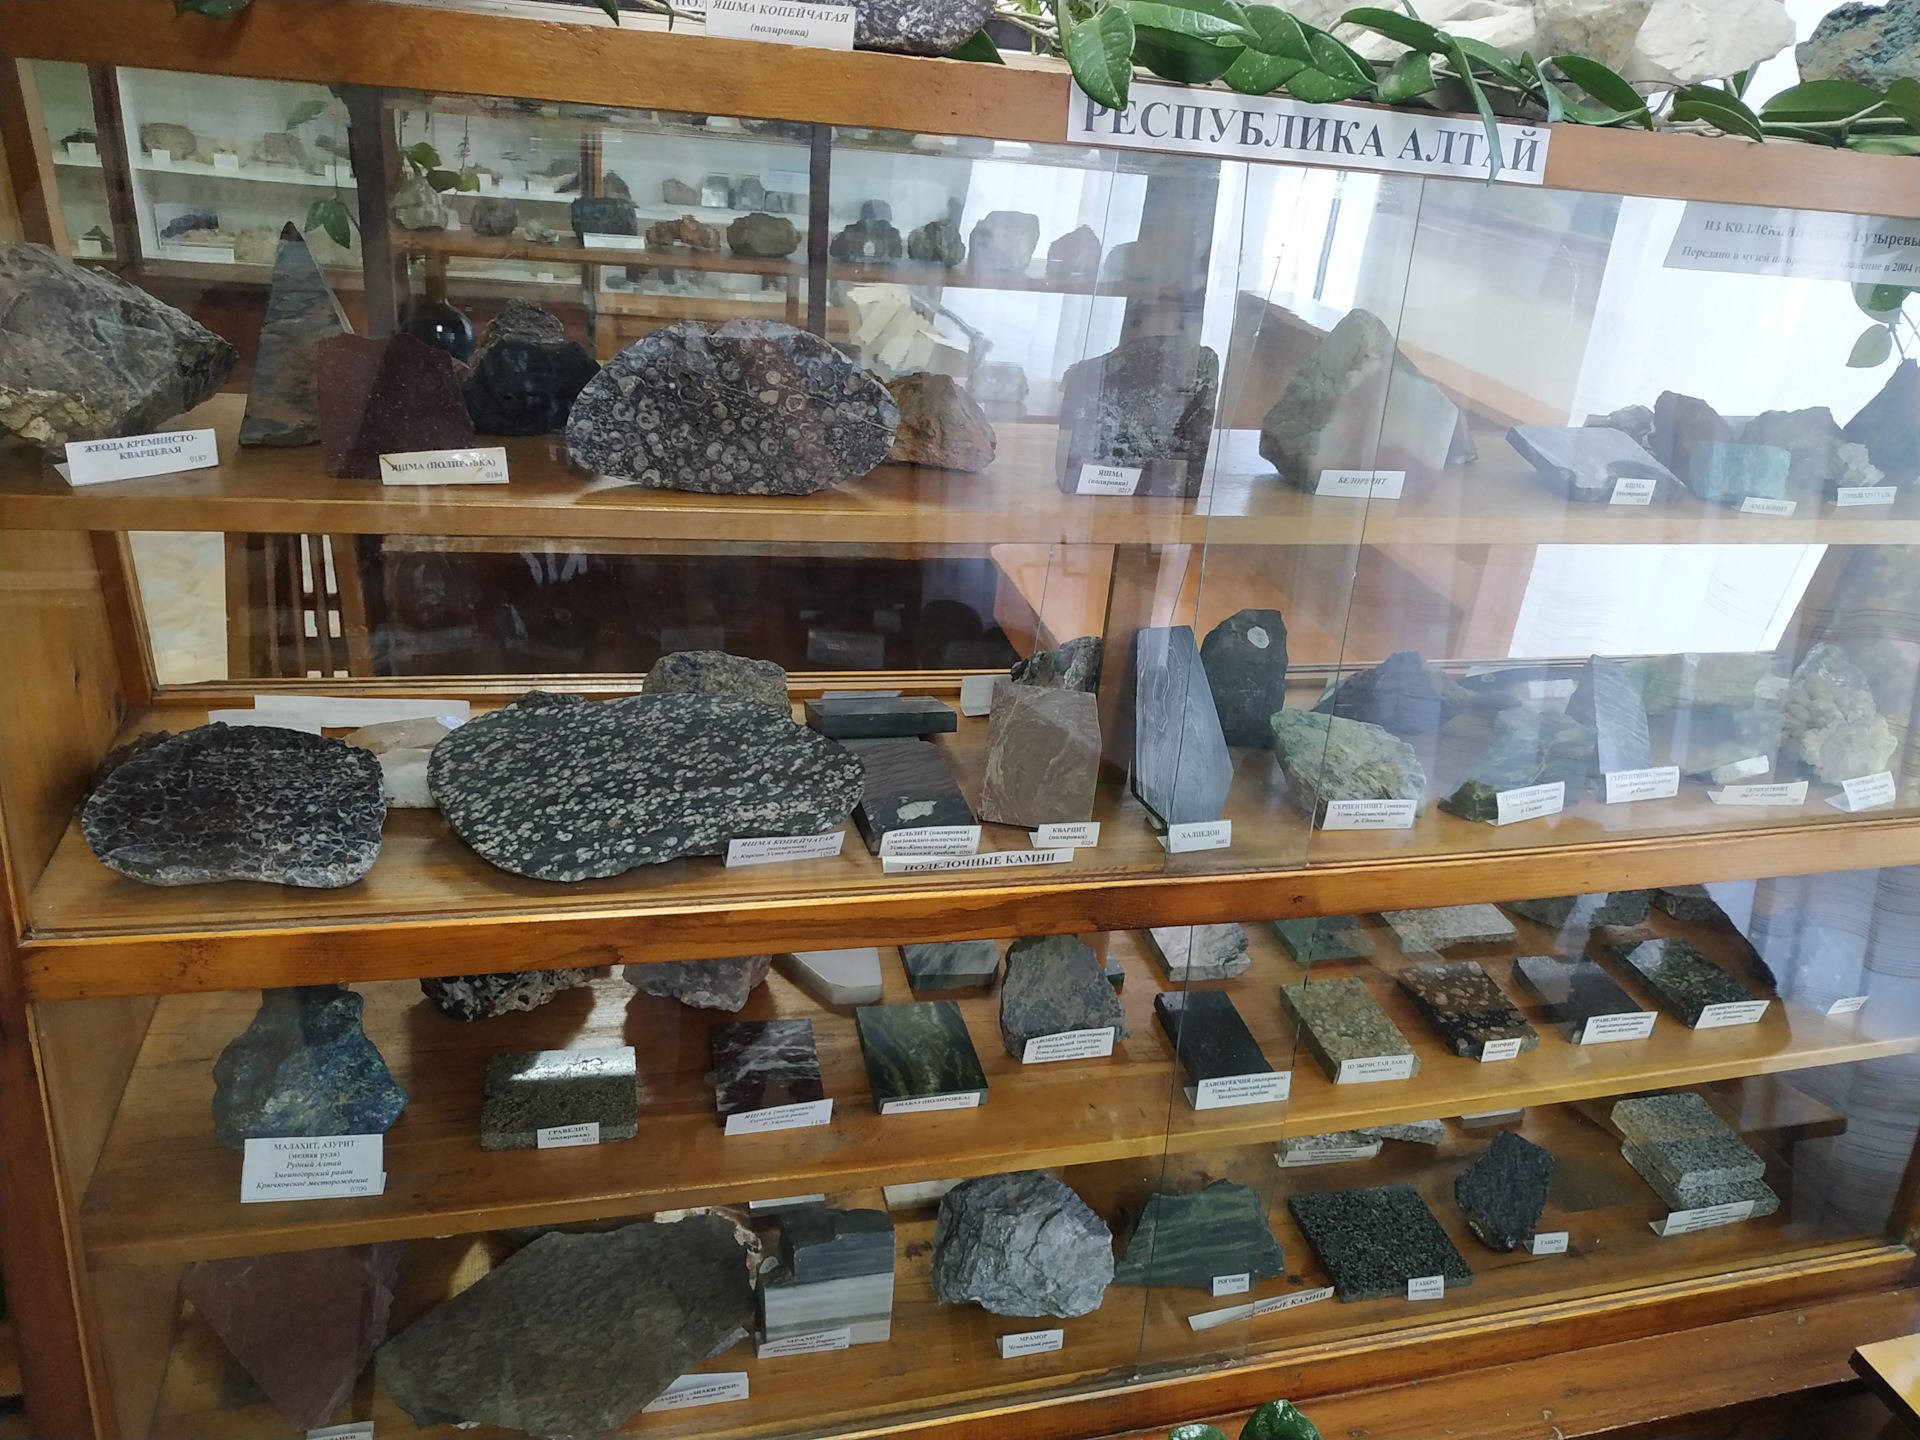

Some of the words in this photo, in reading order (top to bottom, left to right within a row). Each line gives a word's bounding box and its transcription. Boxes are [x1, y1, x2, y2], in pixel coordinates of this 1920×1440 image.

[712, 0, 755, 14] ЯШМА
[759, 4, 850, 23] КОПЕЙЧАТАЯ
[750, 23, 809, 38] (полировка)
[1080, 96, 1385, 158] РЕСПУБЛИКА
[1681, 245, 1730, 260] Передано
[1741, 251, 1770, 264] музей
[1891, 262, 1913, 273] 2004
[85, 443, 125, 454] ЖЕОДА
[127, 434, 198, 449] КРЕМНИСТО-
[120, 446, 182, 461] КВАРЦЕВАЯ
[190, 455, 207, 464] 0187
[426, 459, 497, 471] (ПОЛИРОВКА)
[1097, 469, 1124, 479] ЯШМА
[1087, 478, 1129, 488] (полировка)
[1332, 802, 1382, 810] СЕРПЕНТИНИТ
[892, 830, 927, 838] ФЕЛЬЗИТ
[929, 829, 970, 837] (полировка)
[1052, 826, 1087, 834] КВАРЦИТ
[1181, 829, 1221, 839] ХАЛЦЕДОН
[740, 840, 772, 849] ЯШМА
[773, 835, 835, 846] КОПЕЙЧАТАЯ
[947, 843, 969, 852] район
[904, 854, 1002, 872] ПОДЕЛОЧНЫЕ
[1005, 852, 1056, 865] КАМНИ
[1592, 1016, 1622, 1024] ГРАВЕЛИТ
[1030, 1033, 1077, 1046] ЛАВОБРЕКЧИЯ
[1347, 1061, 1389, 1070] ПУЗЫРИСТАЯ
[1203, 1078, 1251, 1088] ЛАВОБРЕКЧИЯ
[1260, 1082, 1277, 1090] район
[894, 1100, 921, 1108] ДИАБАЗ
[921, 1095, 971, 1105] (ПОЛИРОВКА)
[743, 1110, 772, 1120] ЯШМА
[548, 1126, 588, 1135] ГРАВЕЛИТ
[273, 1142, 321, 1151] МАЛАХИТ,
[321, 1140, 356, 1149] АЗУРИТ
[287, 1153, 318, 1162] (медная
[319, 1151, 341, 1161] руда)
[286, 1161, 315, 1170] Рудный
[316, 1160, 342, 1168] Алтай
[273, 1170, 330, 1179] Змеиногорский
[330, 1168, 354, 1178] район
[256, 1180, 307, 1191] Крючковское
[307, 1177, 369, 1188] месторождение
[350, 1185, 368, 1193] 0709
[1540, 1238, 1562, 1246] ГАББРО
[1217, 1276, 1245, 1285] РОГОВИК
[1415, 1279, 1438, 1288] ГАББРО
[1290, 1291, 1327, 1307] КАМНИ
[785, 1334, 825, 1344] МРАМОР
[1019, 1333, 1048, 1342] МРАМОР
[1041, 1339, 1058, 1347] район
